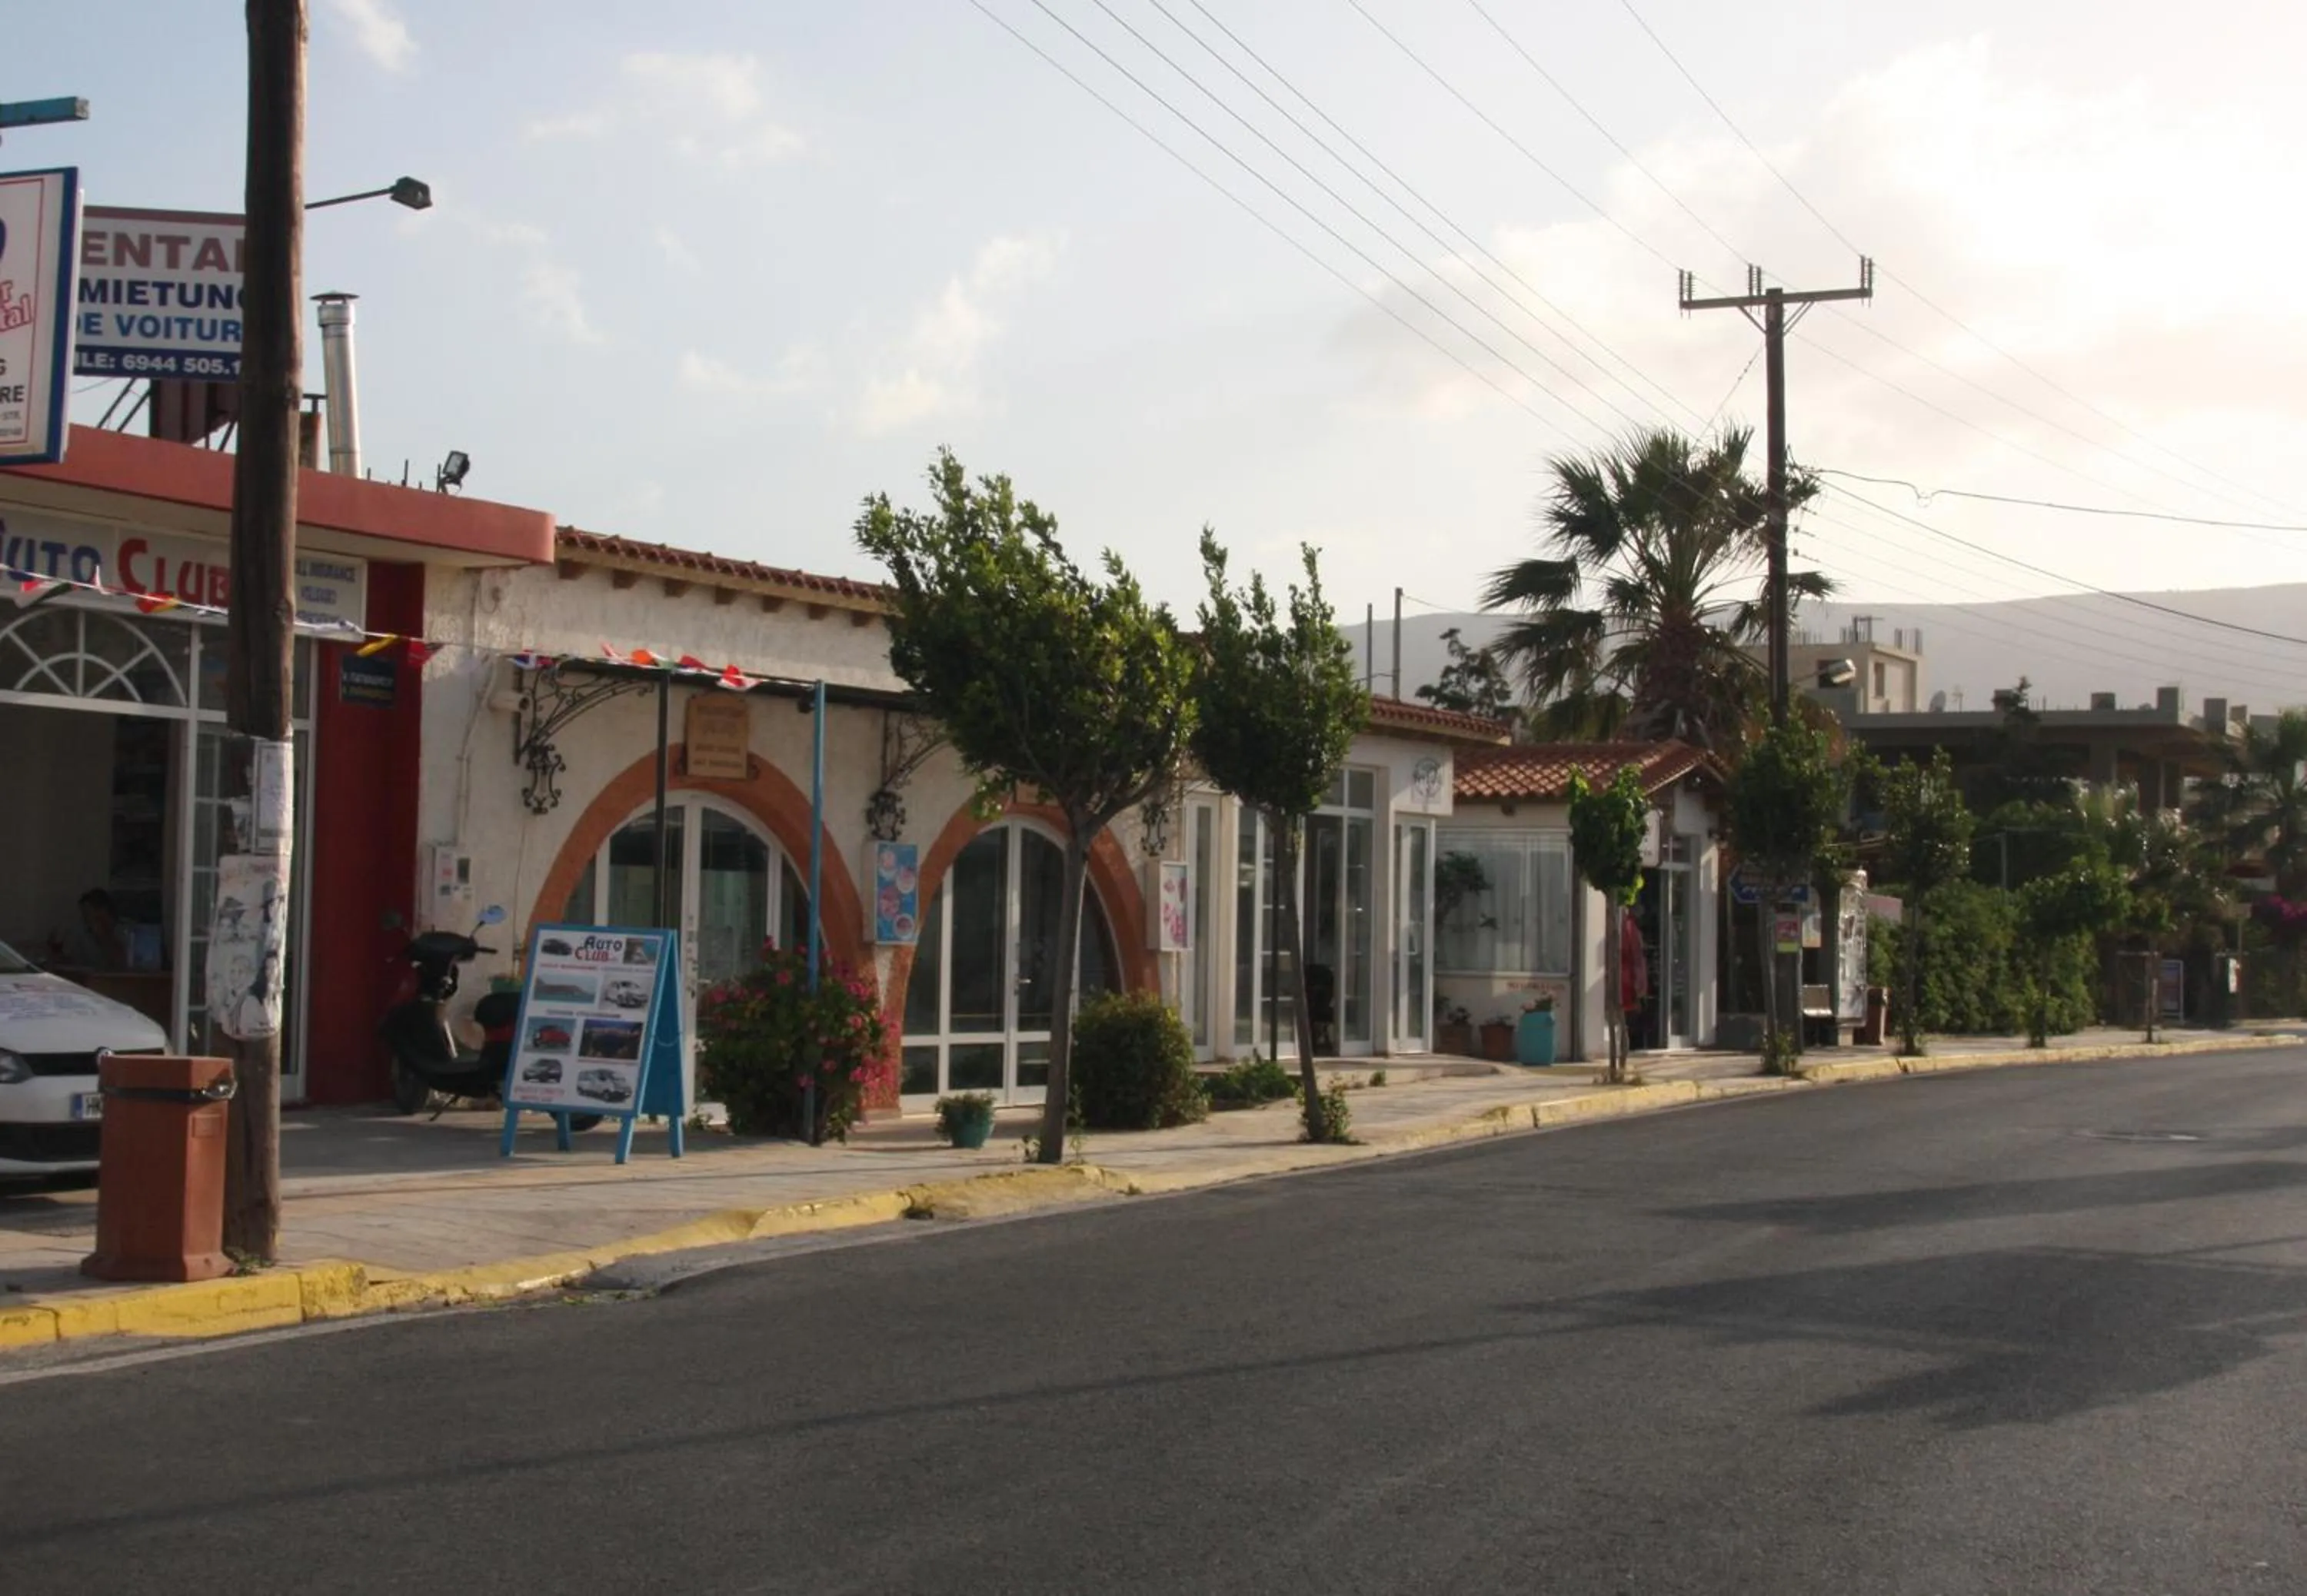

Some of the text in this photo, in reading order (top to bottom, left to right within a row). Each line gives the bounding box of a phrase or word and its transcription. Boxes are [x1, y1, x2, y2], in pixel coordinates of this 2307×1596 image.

[76, 312, 241, 343] E VOITUR
[122, 354, 177, 374] 6944
[0, 517, 230, 607] UTO CLUB
[583, 934, 623, 953] AUTO
[574, 946, 609, 963] CLUB
